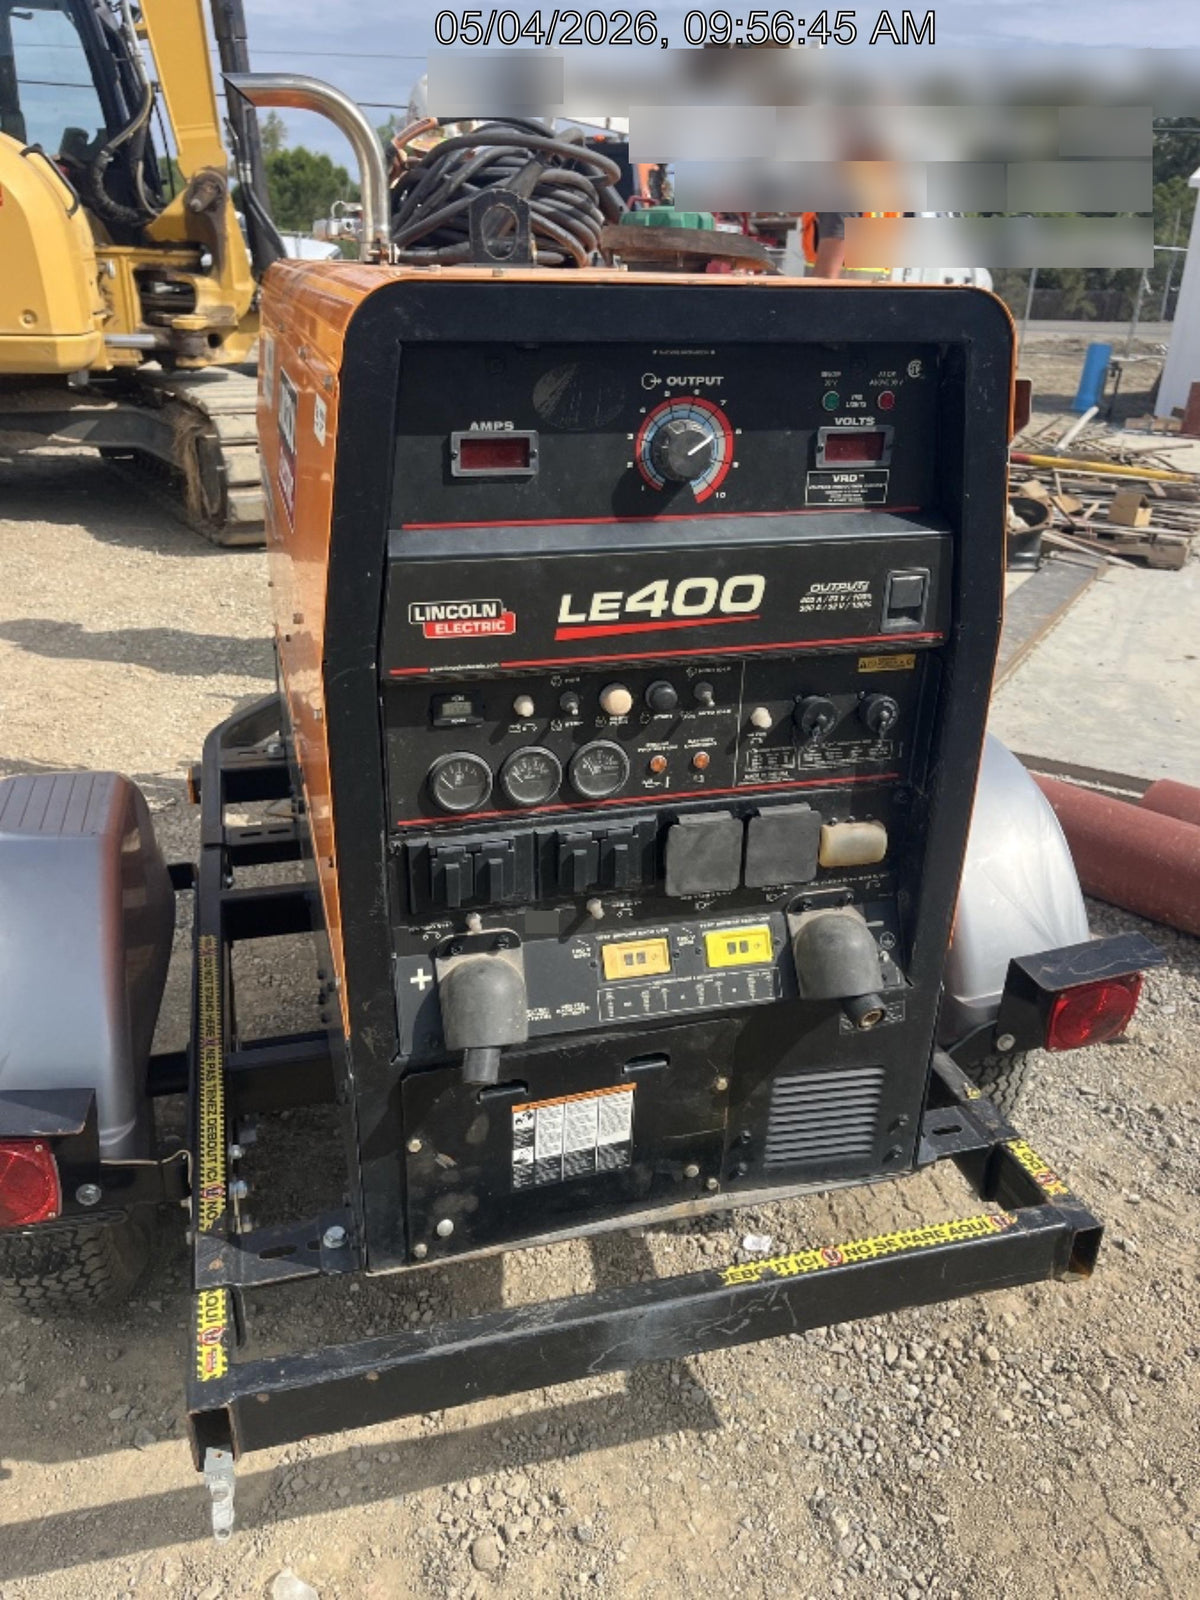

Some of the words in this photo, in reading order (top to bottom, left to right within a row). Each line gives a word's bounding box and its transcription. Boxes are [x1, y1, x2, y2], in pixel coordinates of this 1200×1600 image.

[667, 376, 724, 386] OUTPUT
[469, 421, 515, 431] AMPS
[834, 416, 876, 426] VOLTS
[557, 574, 766, 623] LE400
[414, 603, 497, 621] LINCOLN
[435, 620, 506, 634] ELECTRIC
[206, 1063, 217, 1082] PAS
[206, 1084, 217, 1117] TENEZ
[206, 1118, 218, 1164] DEBOUT
[206, 1201, 218, 1220] NO
[844, 1242, 872, 1258] NO
[874, 1238, 897, 1252] SE
[901, 1230, 946, 1246] PARE
[950, 1220, 991, 1236] AQUI
[795, 1255, 819, 1269] ICI
[205, 1290, 219, 1323] QUI
